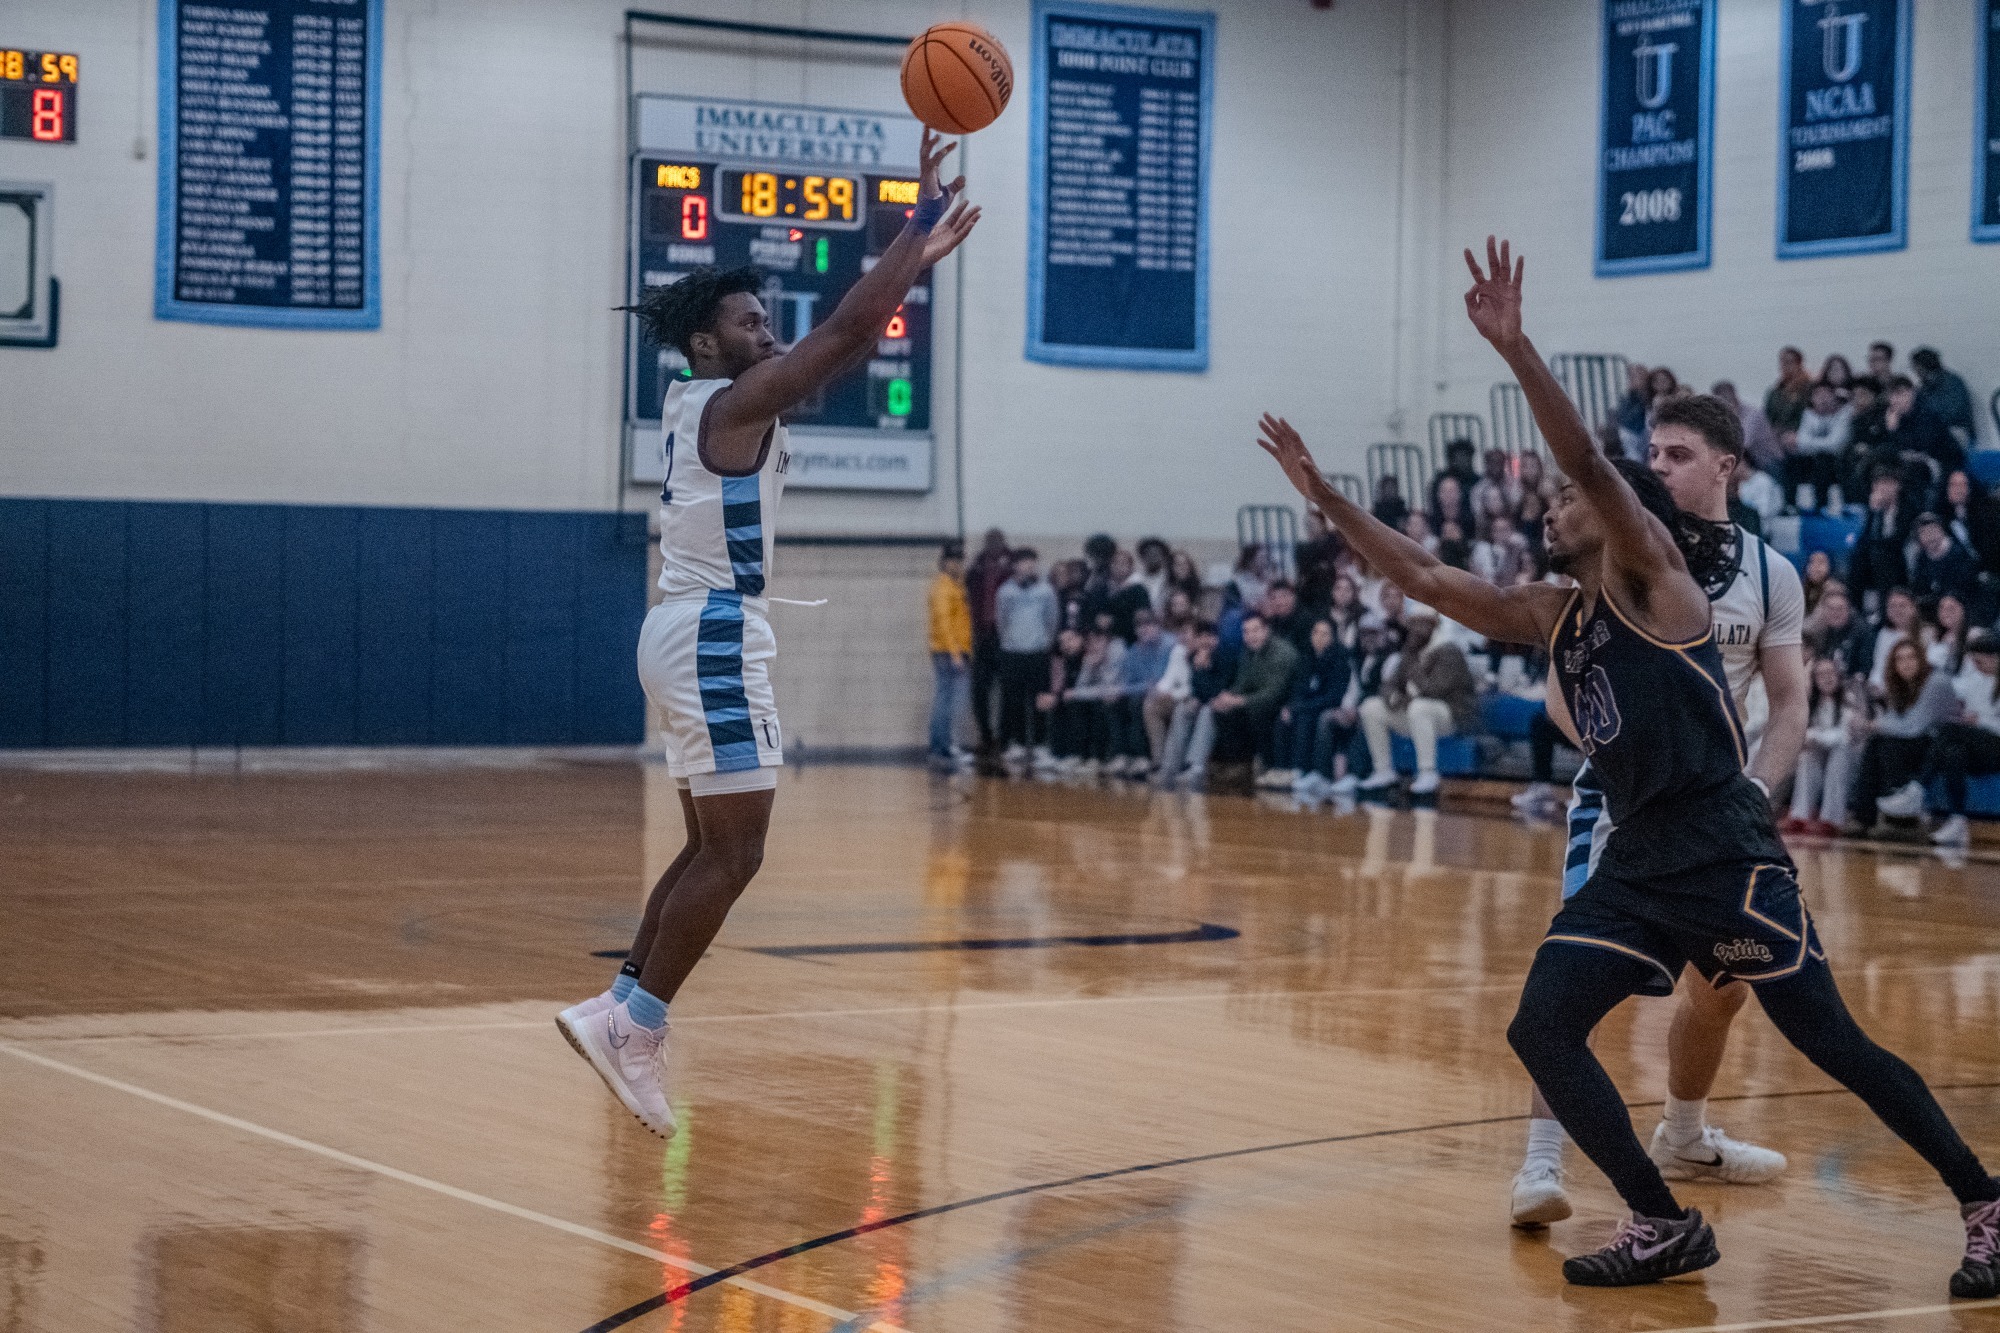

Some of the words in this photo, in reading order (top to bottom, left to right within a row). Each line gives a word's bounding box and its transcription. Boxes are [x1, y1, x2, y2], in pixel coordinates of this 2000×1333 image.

[33, 88, 63, 140] 8
[1804, 82, 1876, 119] NCAA
[696, 107, 885, 141] IMMACULATA
[696, 131, 882, 166] UNIVERSITY
[741, 172, 853, 220] 18:59
[1619, 187, 1681, 225] 2008
[682, 195, 707, 240] 0
[1712, 624, 1751, 645] LATA
